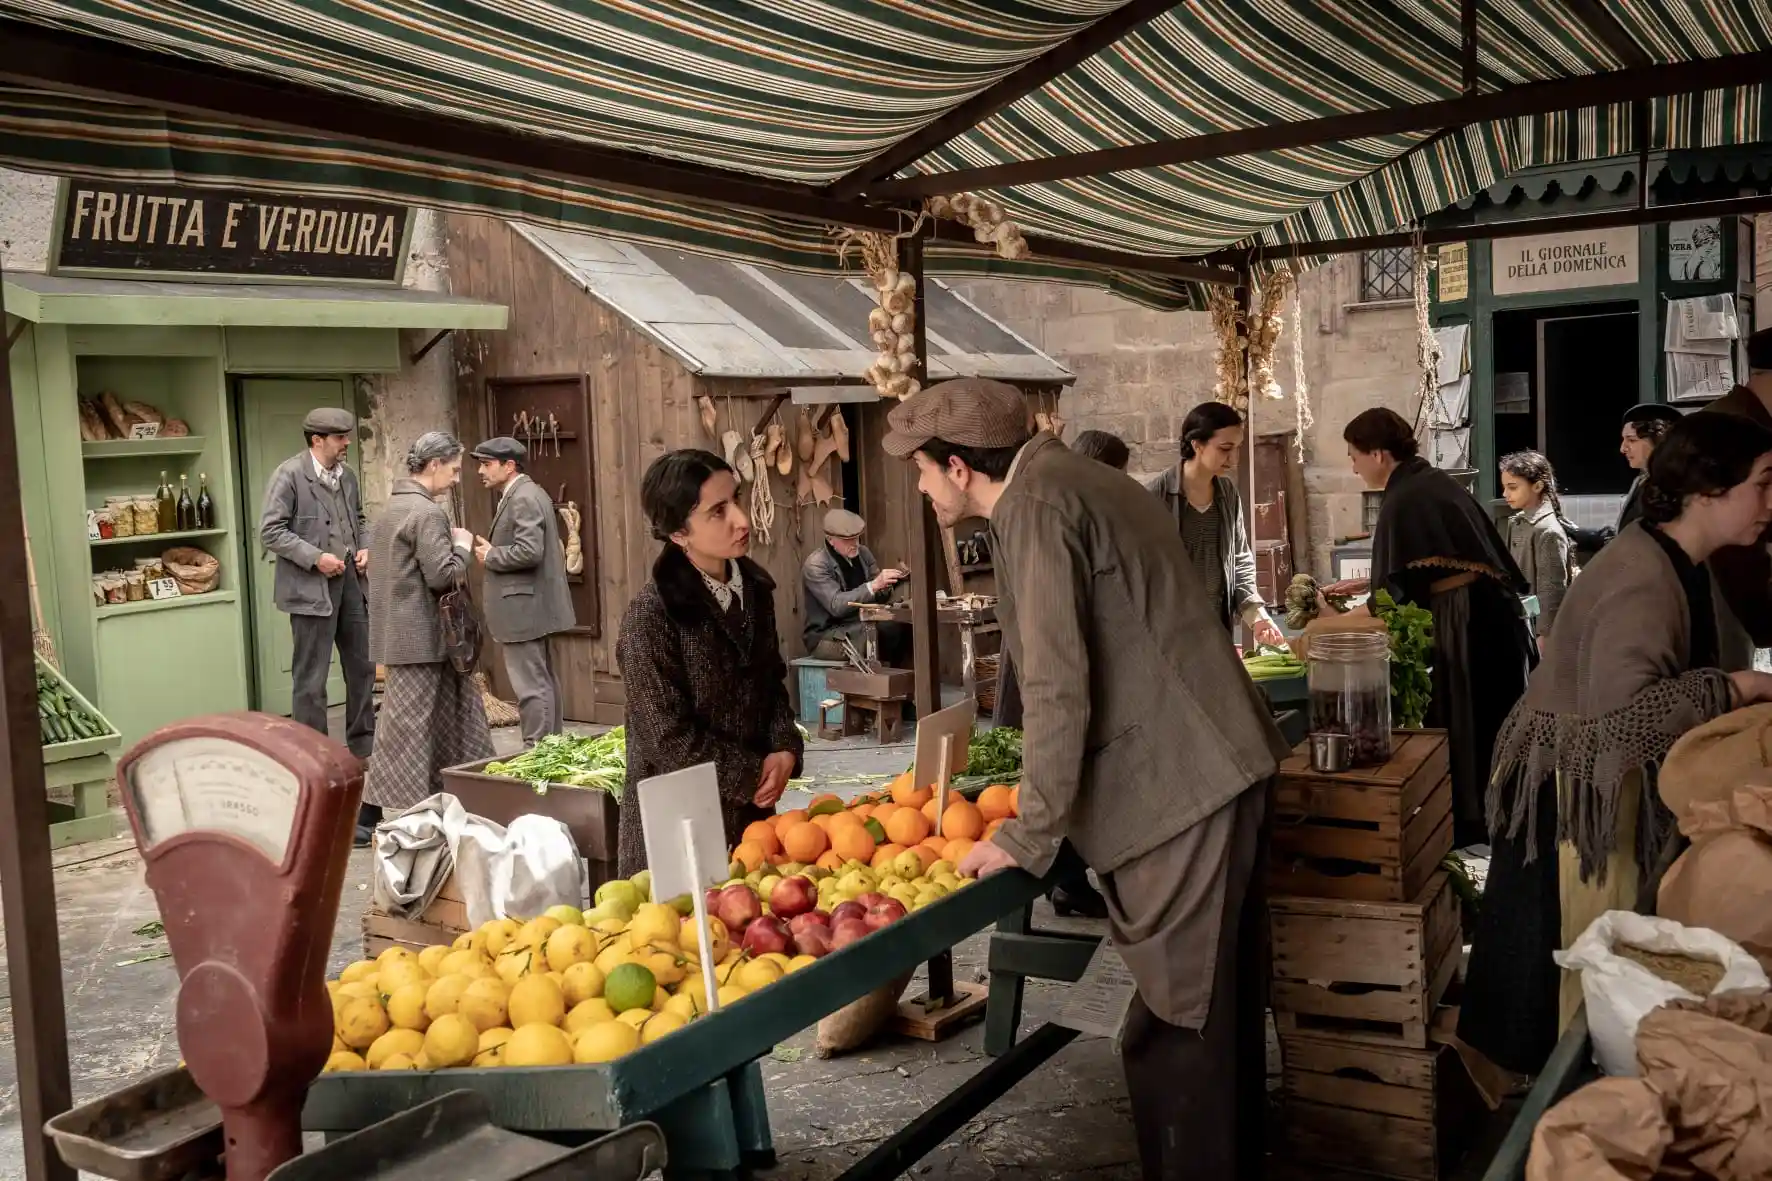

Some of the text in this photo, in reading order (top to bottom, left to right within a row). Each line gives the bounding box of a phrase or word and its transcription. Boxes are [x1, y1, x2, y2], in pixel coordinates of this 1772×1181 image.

[72, 189, 395, 257] FRUTTA E VERDURA
[1521, 241, 1608, 263] IL GIORNALE
[1508, 255, 1627, 278] DELLA DOMENICA
